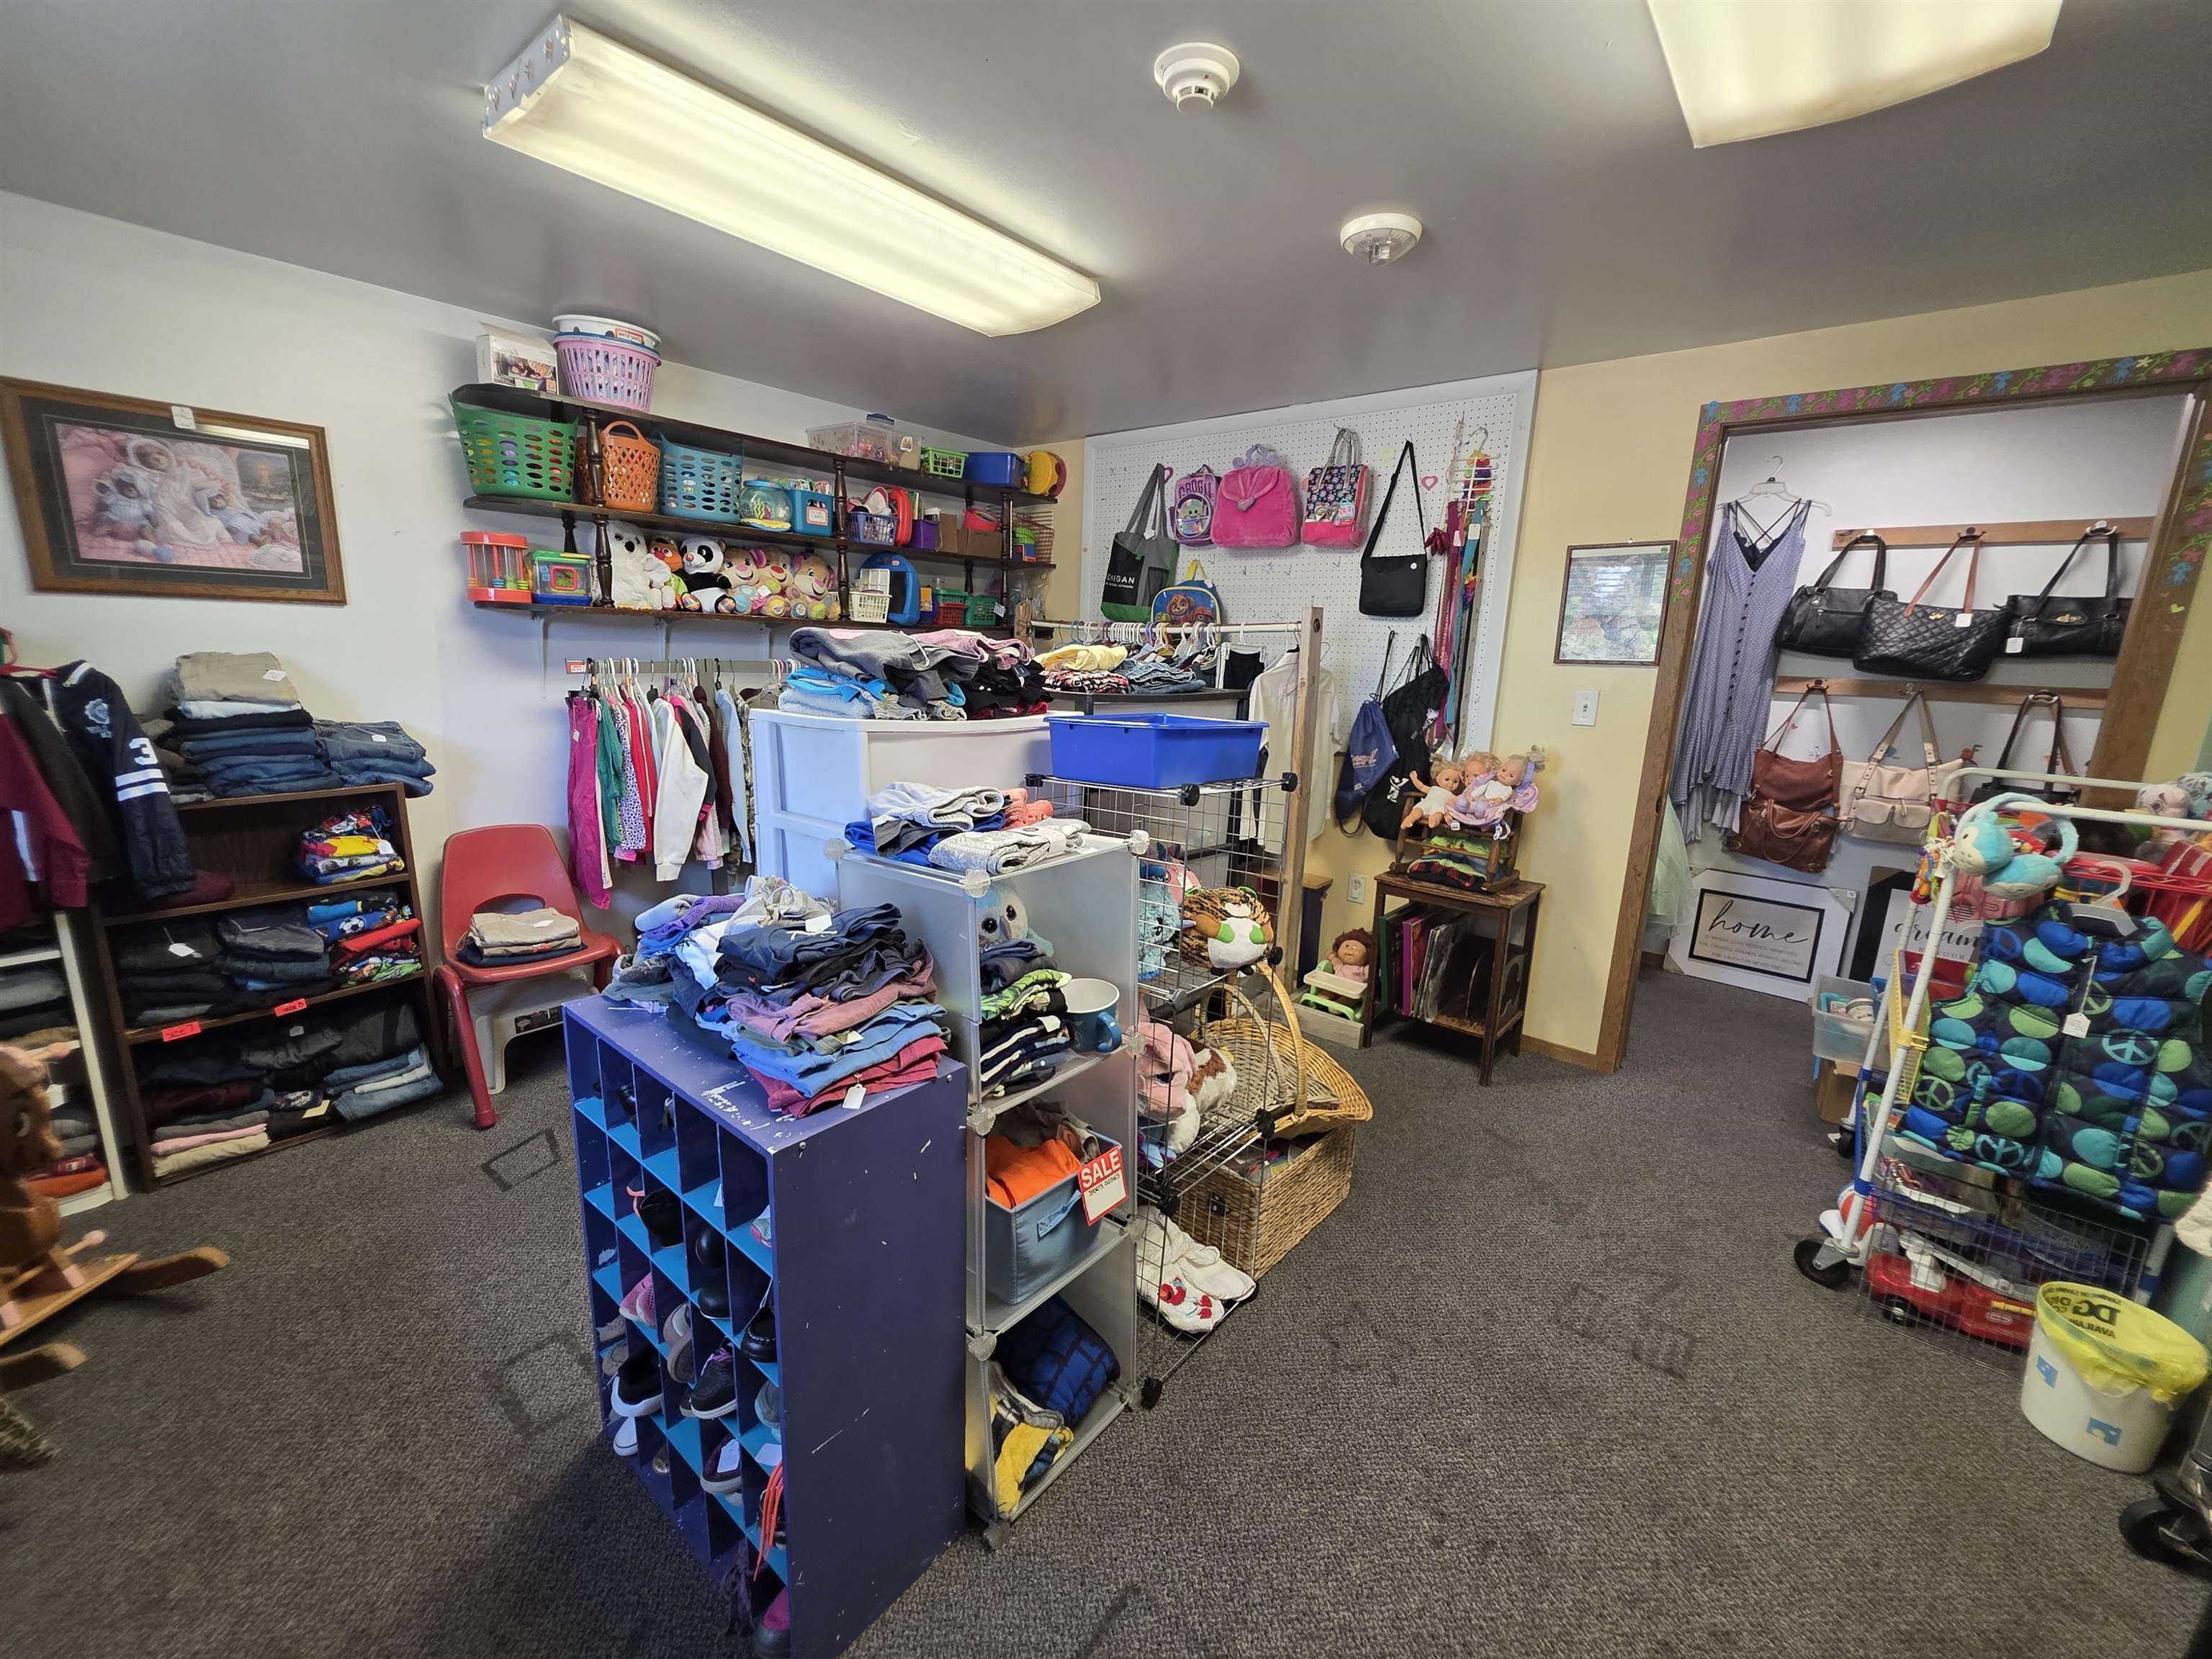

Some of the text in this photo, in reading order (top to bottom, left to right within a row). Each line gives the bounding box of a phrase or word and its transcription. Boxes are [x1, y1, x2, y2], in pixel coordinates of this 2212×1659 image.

[129, 737, 158, 765] 3
[1709, 899, 1809, 943] home
[1081, 1150, 1121, 1188] SALE
